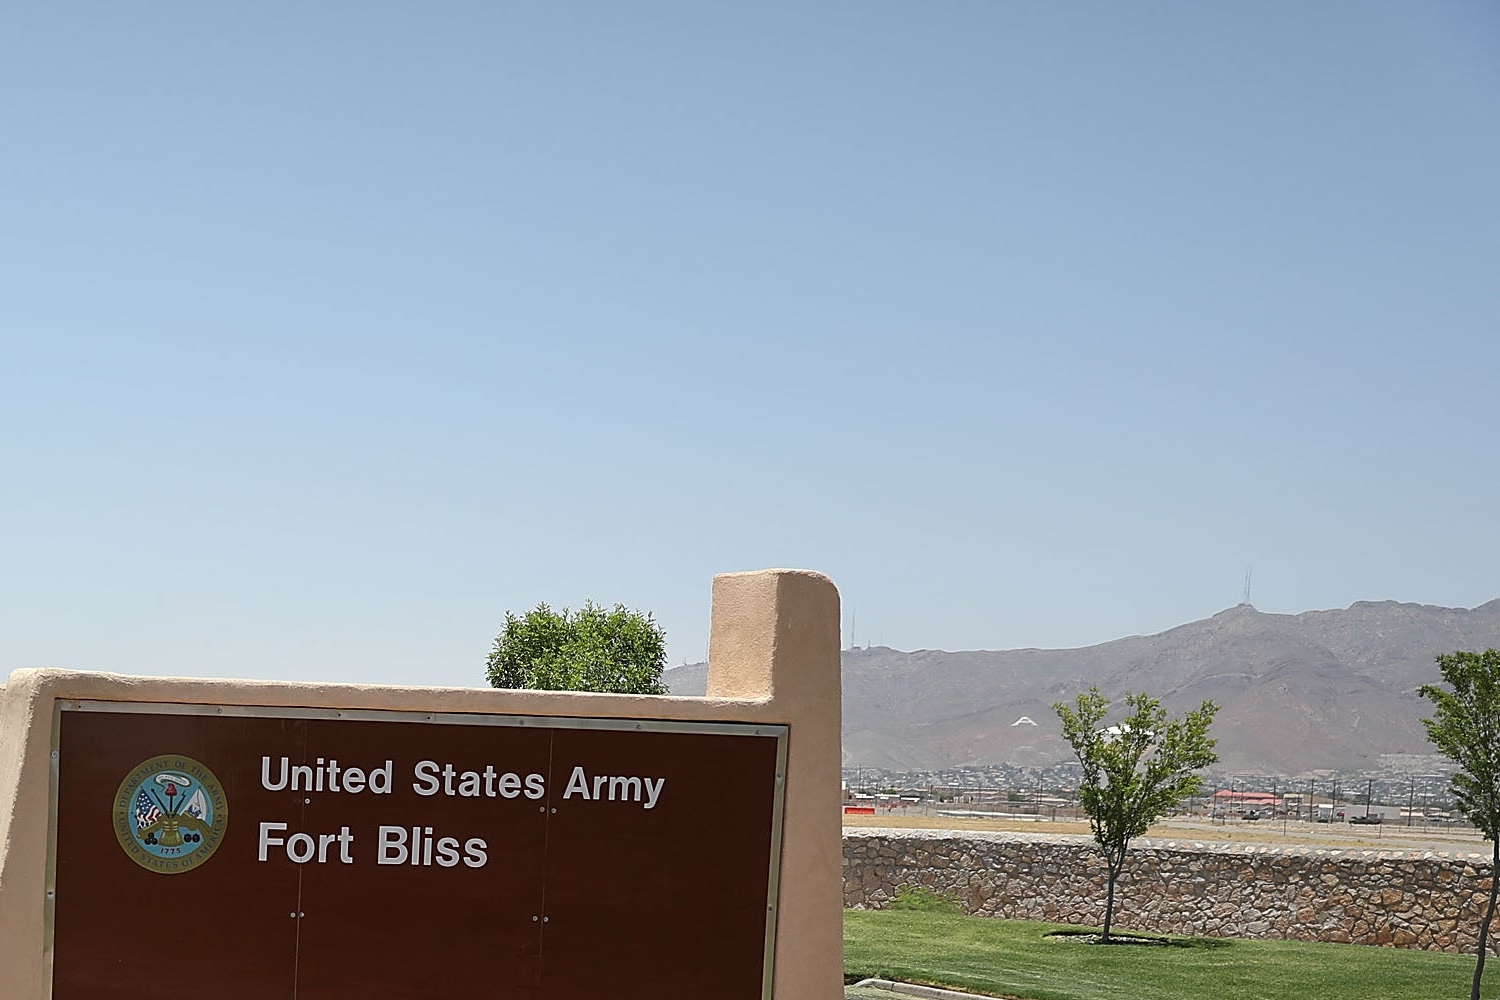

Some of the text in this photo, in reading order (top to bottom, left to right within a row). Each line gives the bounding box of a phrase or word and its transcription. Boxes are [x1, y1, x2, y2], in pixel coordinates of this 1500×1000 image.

[175, 761, 188, 769] OF
[210, 783, 224, 809] ARMY
[260, 756, 666, 809] United States Army
[257, 822, 488, 868] Fort Bliss
